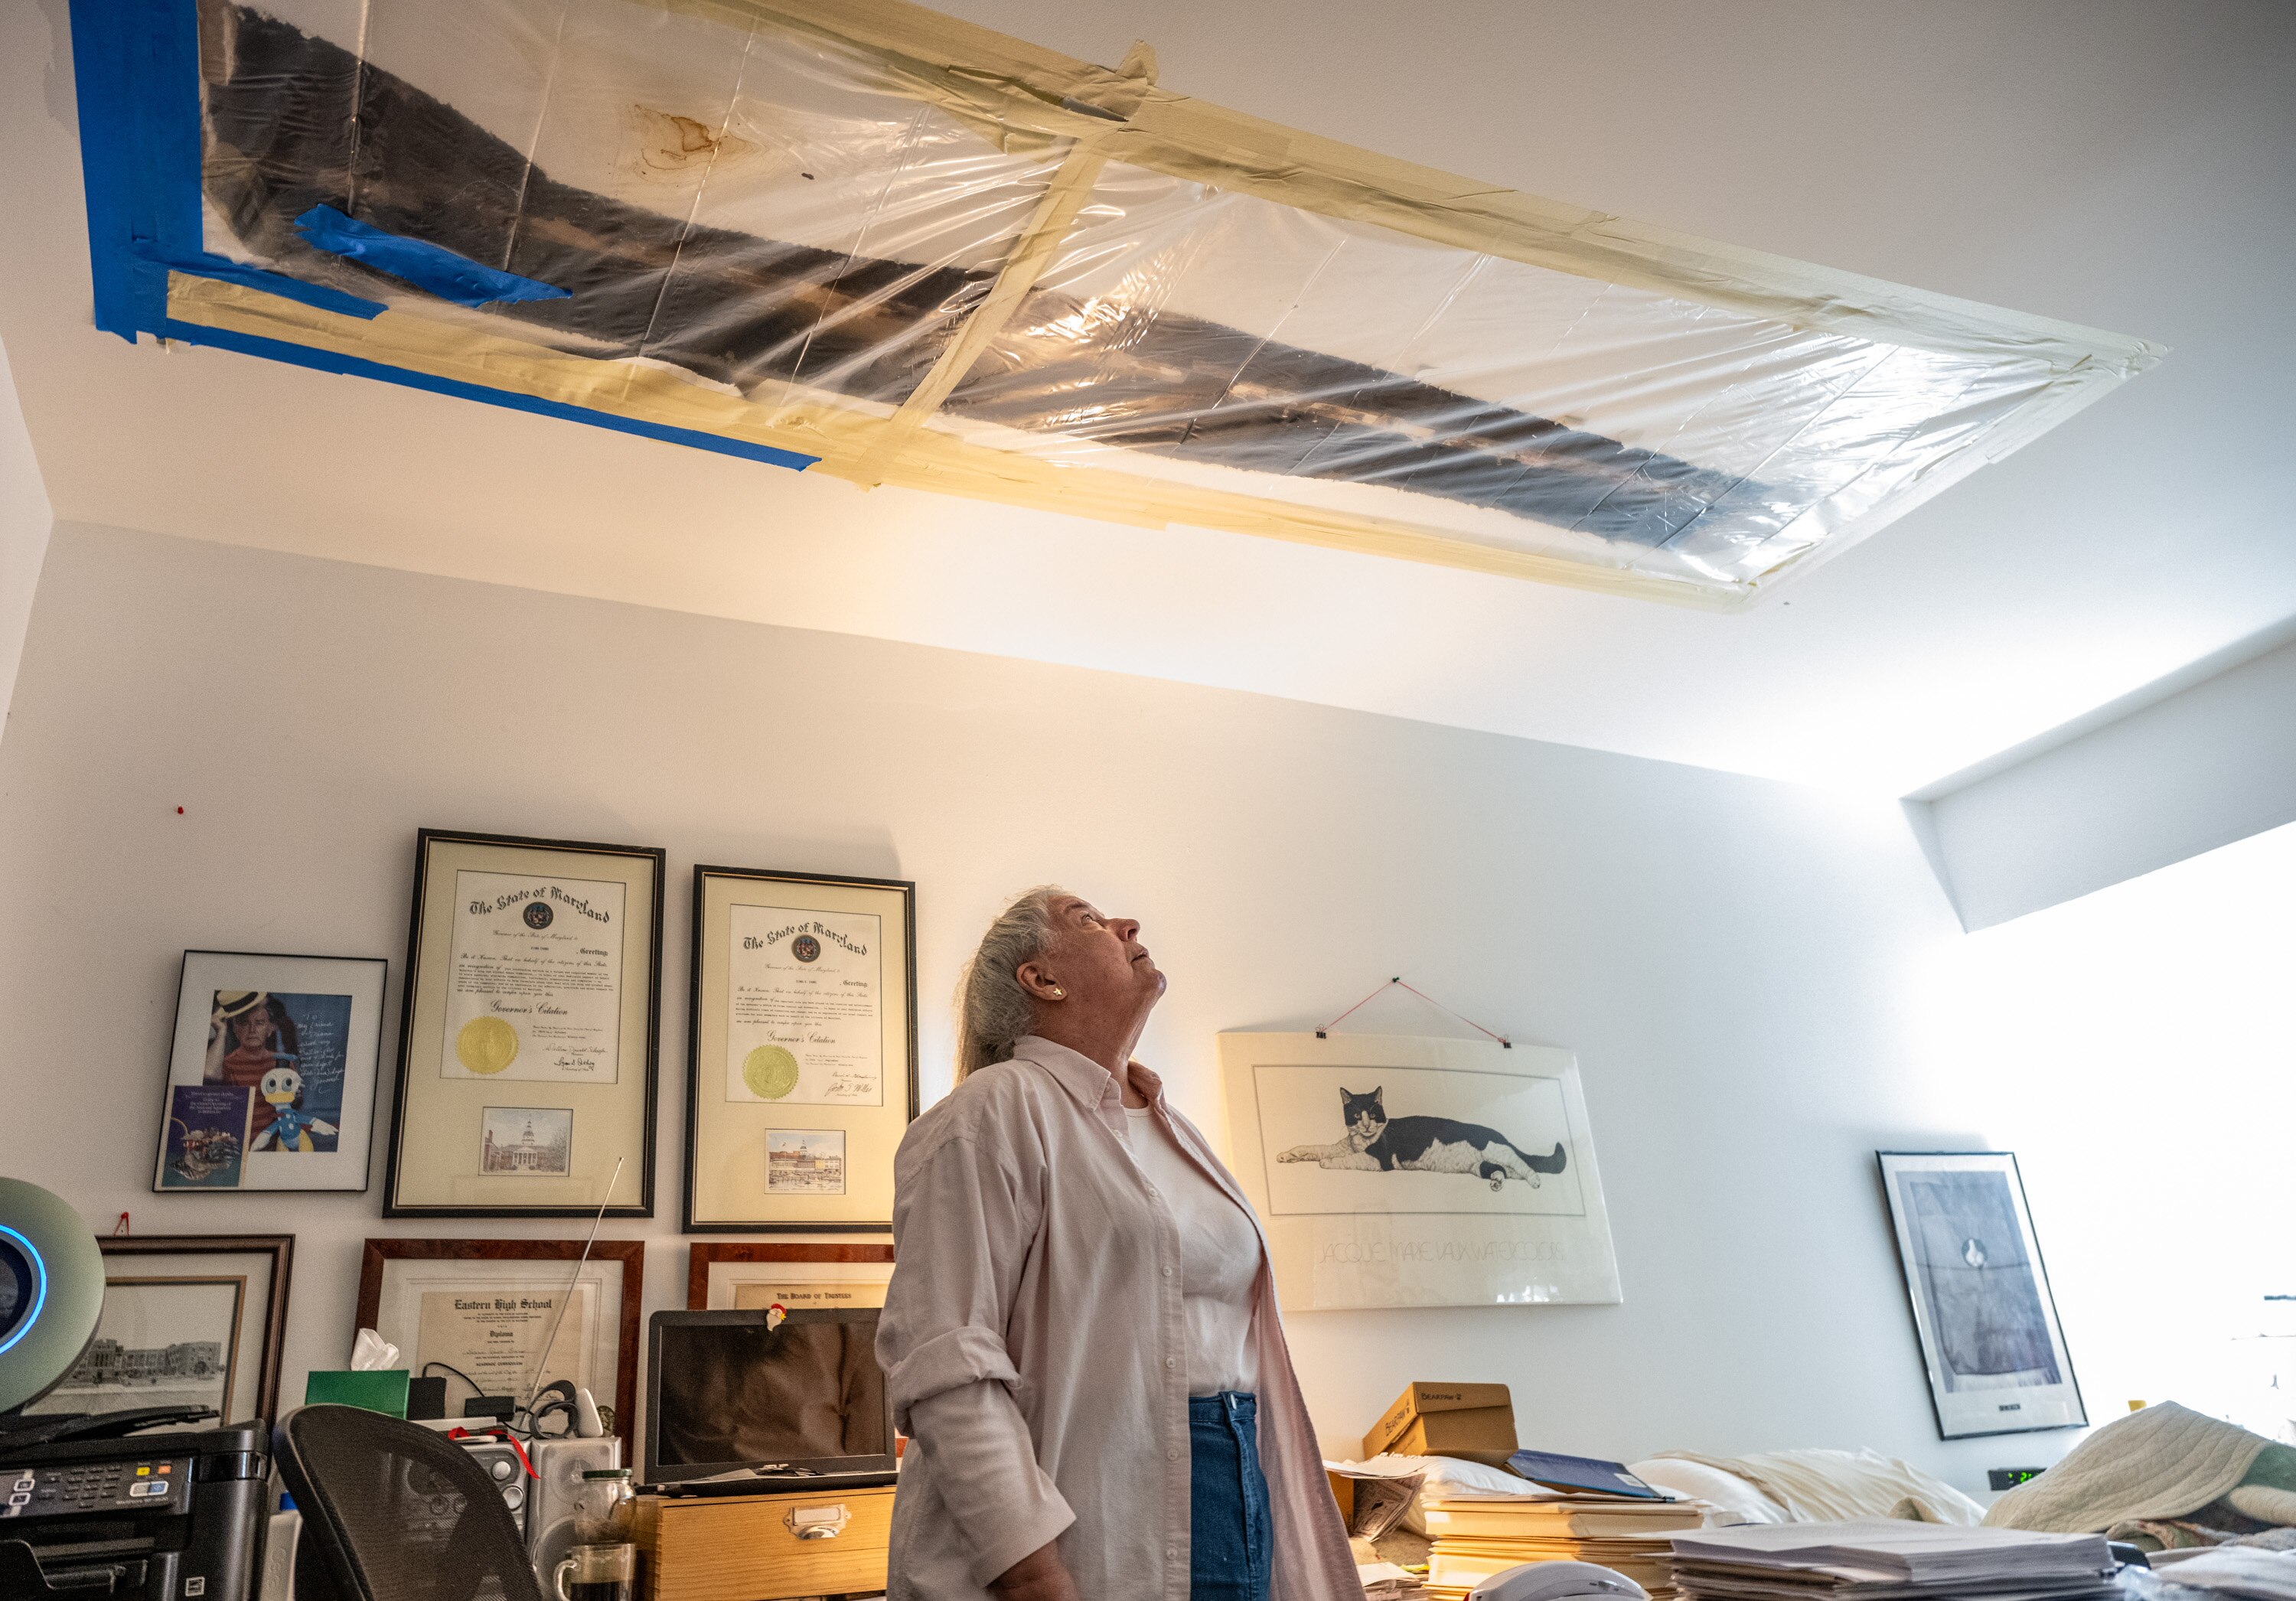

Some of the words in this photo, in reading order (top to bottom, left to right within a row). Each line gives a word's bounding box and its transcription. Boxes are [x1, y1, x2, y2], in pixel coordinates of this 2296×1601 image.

[469, 901, 492, 915] The
[497, 889, 530, 911] State
[533, 886, 546, 898] of
[550, 886, 610, 924] Maryland
[742, 937, 764, 950] The
[767, 925, 795, 945] State
[797, 923, 810, 933] of
[813, 921, 867, 956] Maryland
[490, 999, 533, 1014] Governor's
[536, 1001, 568, 1016] Citation
[765, 1030, 804, 1042] Governor's
[807, 1031, 836, 1044] Citation
[1319, 1241, 1387, 1264] JACQUE
[454, 1299, 491, 1310] Eastern
[494, 1299, 517, 1312] High
[520, 1299, 552, 1311] School
